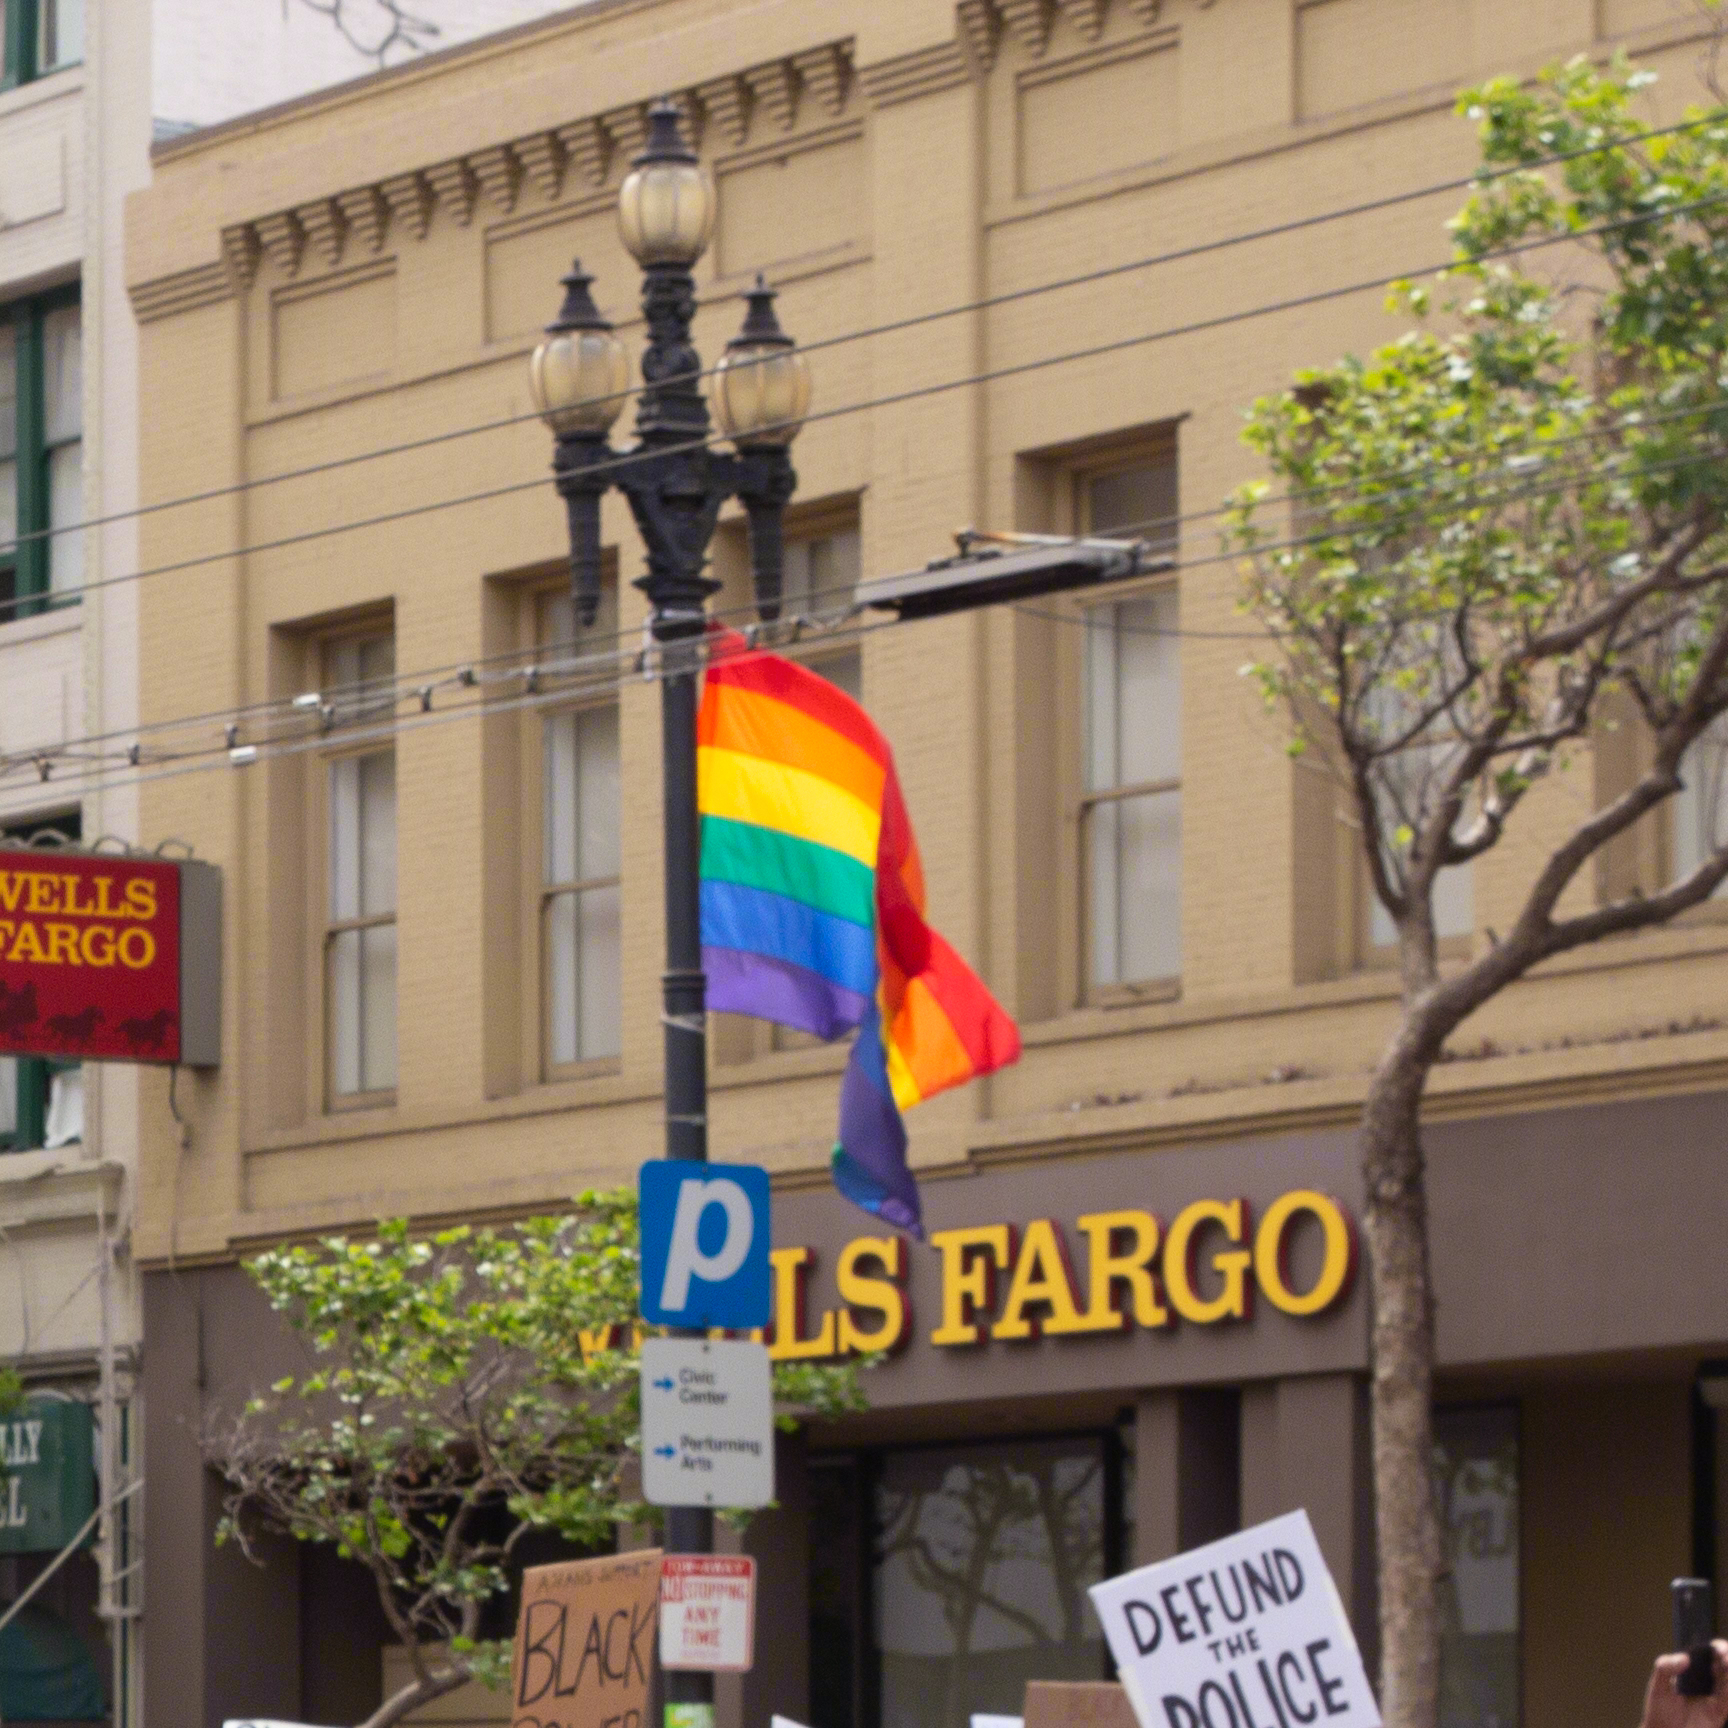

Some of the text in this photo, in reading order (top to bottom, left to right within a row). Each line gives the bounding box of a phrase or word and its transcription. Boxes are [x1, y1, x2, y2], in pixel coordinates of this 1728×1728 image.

[930, 1188, 1356, 1346] FARGO
[679, 1367, 715, 1385] Civic
[679, 1388, 729, 1405] Center
[680, 1433, 761, 1456] Performing
[681, 1454, 713, 1471] Arts
[1122, 1547, 1306, 1657] DEFUND
[684, 1606, 721, 1625] ANY
[682, 1628, 723, 1648] TIME
[1207, 1628, 1262, 1663] THE
[517, 1600, 658, 1708] BLACK
